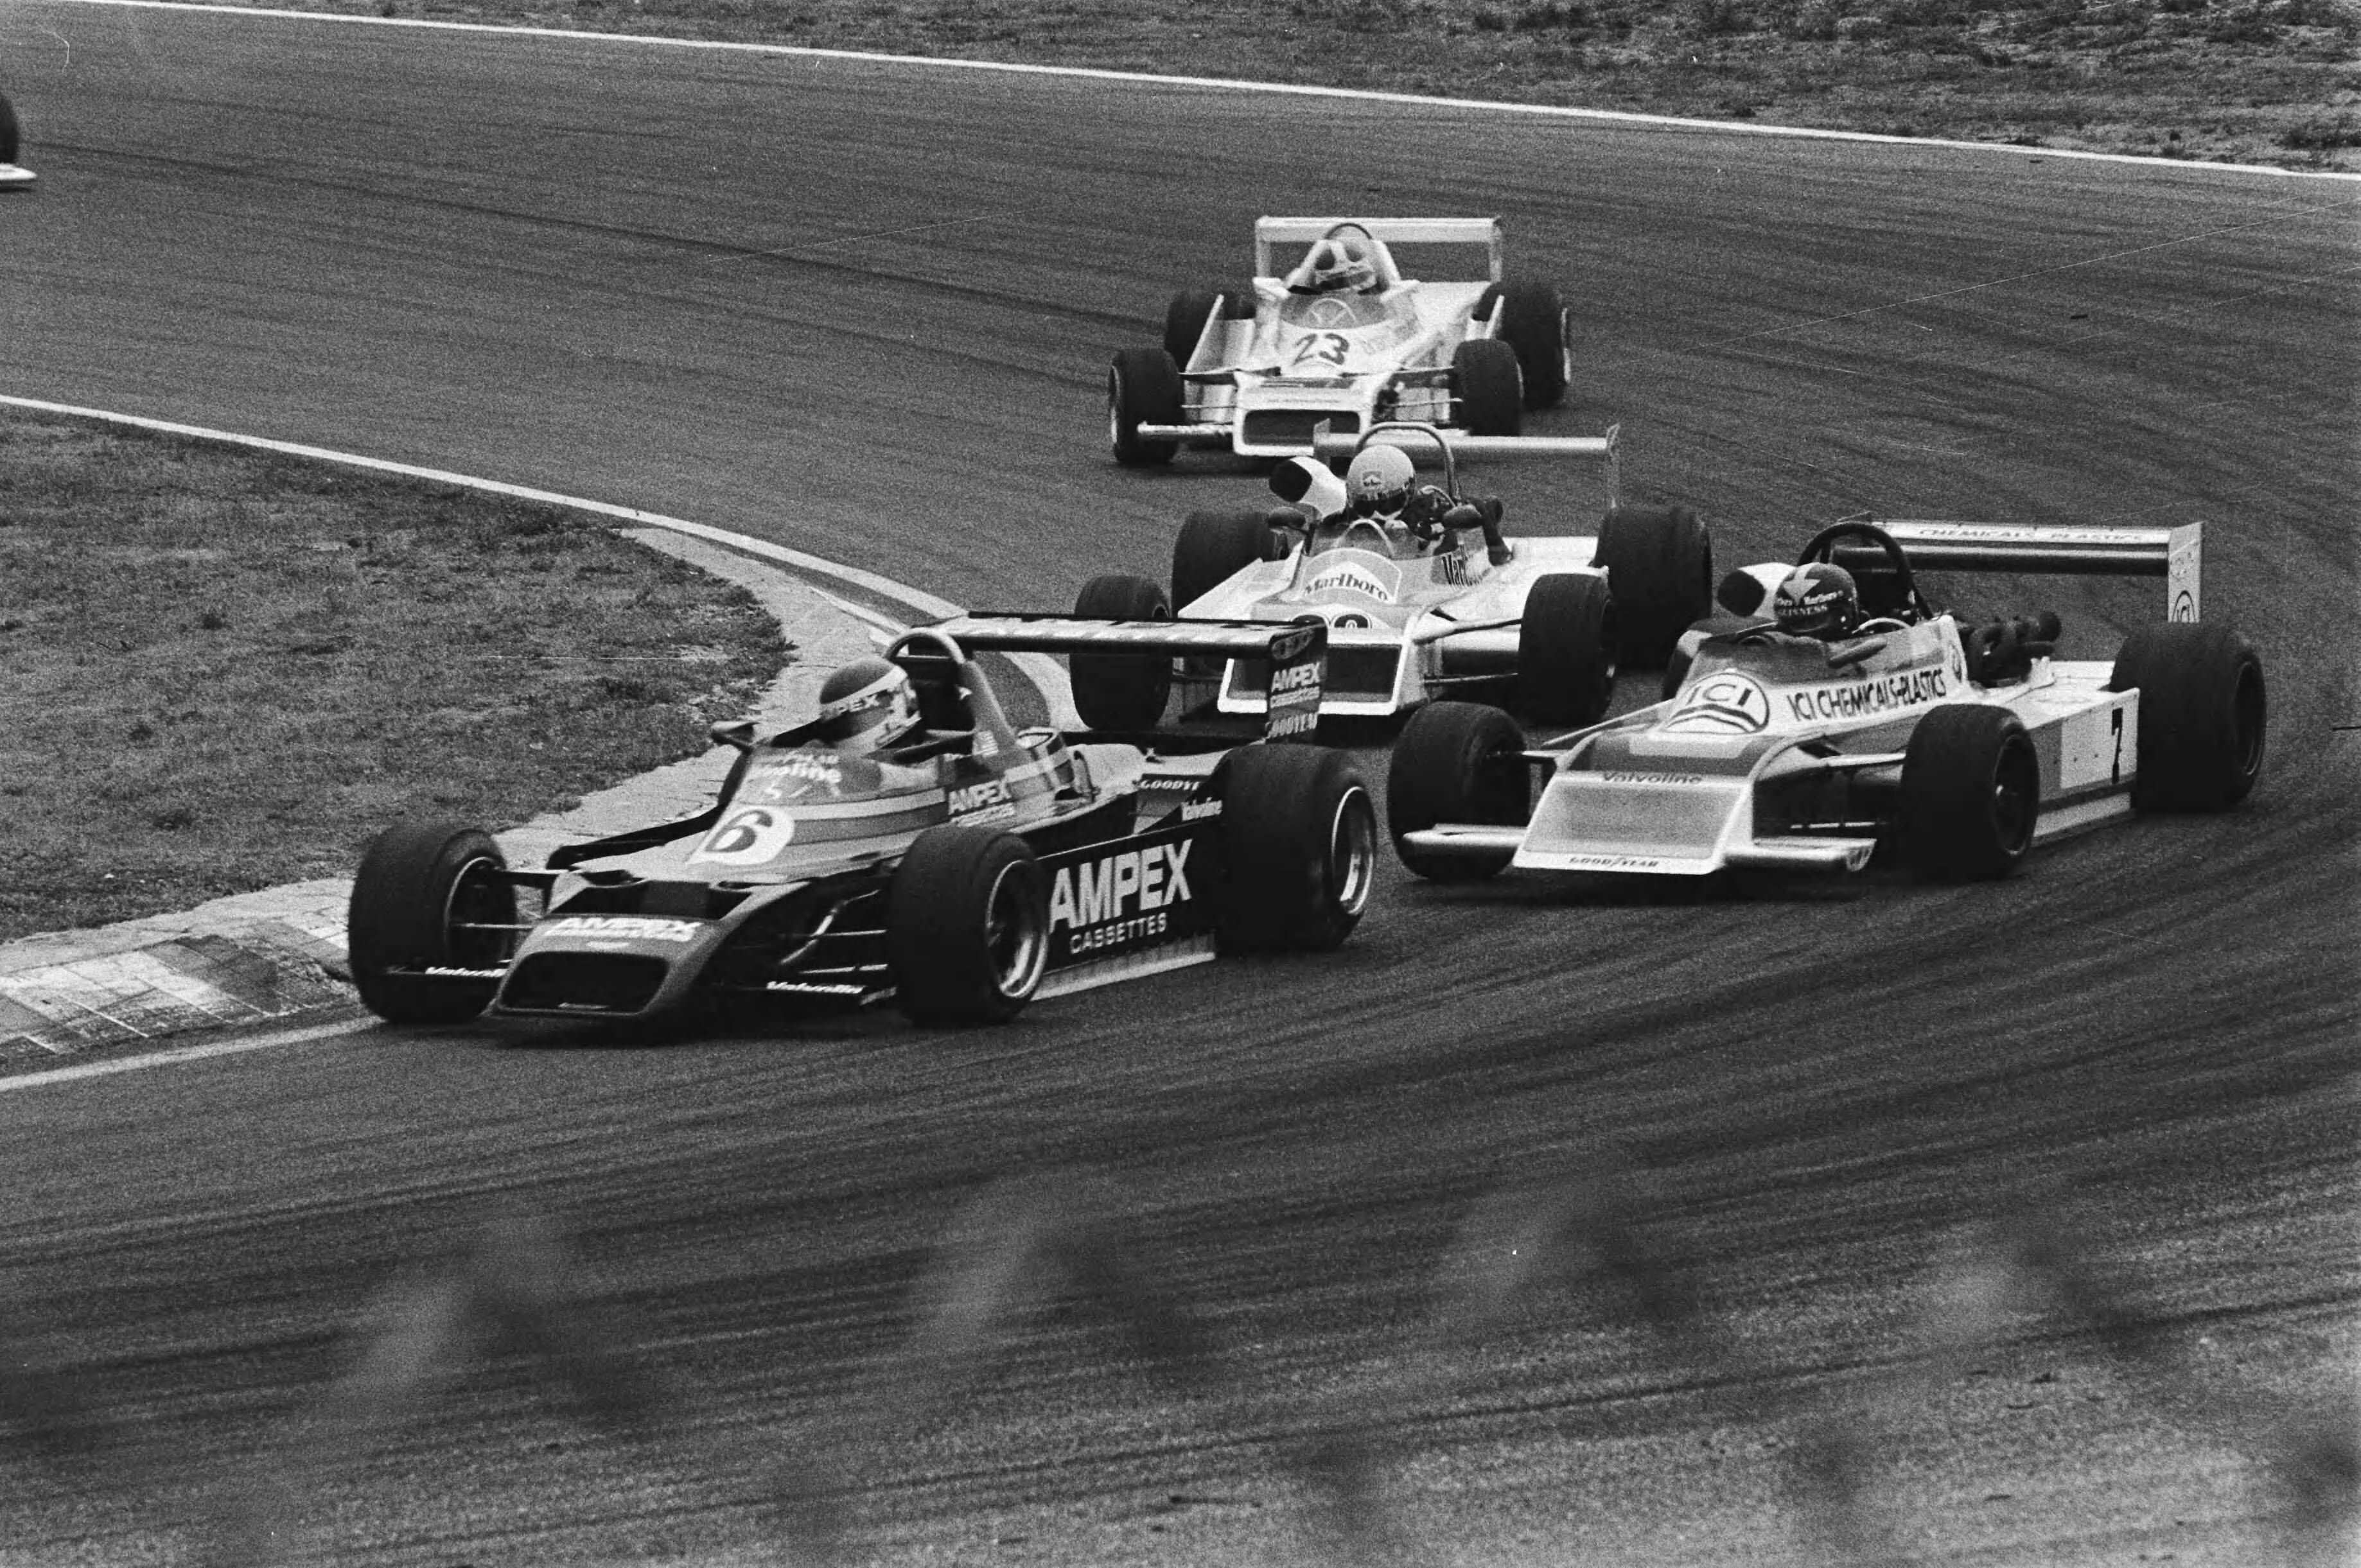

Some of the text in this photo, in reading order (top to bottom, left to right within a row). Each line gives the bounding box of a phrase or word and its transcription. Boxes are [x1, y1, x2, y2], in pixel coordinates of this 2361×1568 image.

[1291, 332, 1350, 367] 23
[1271, 662, 1321, 693] AMPEX
[1685, 683, 1753, 706] ICI
[1787, 692, 1818, 721] ICI
[2111, 707, 2123, 785] 7
[1604, 771, 1703, 785] Valvoline
[948, 780, 1012, 816] AMPEX
[705, 810, 774, 853] 6
[1048, 838, 1194, 935] AMPEX
[1069, 912, 1168, 955] CASSETTES
